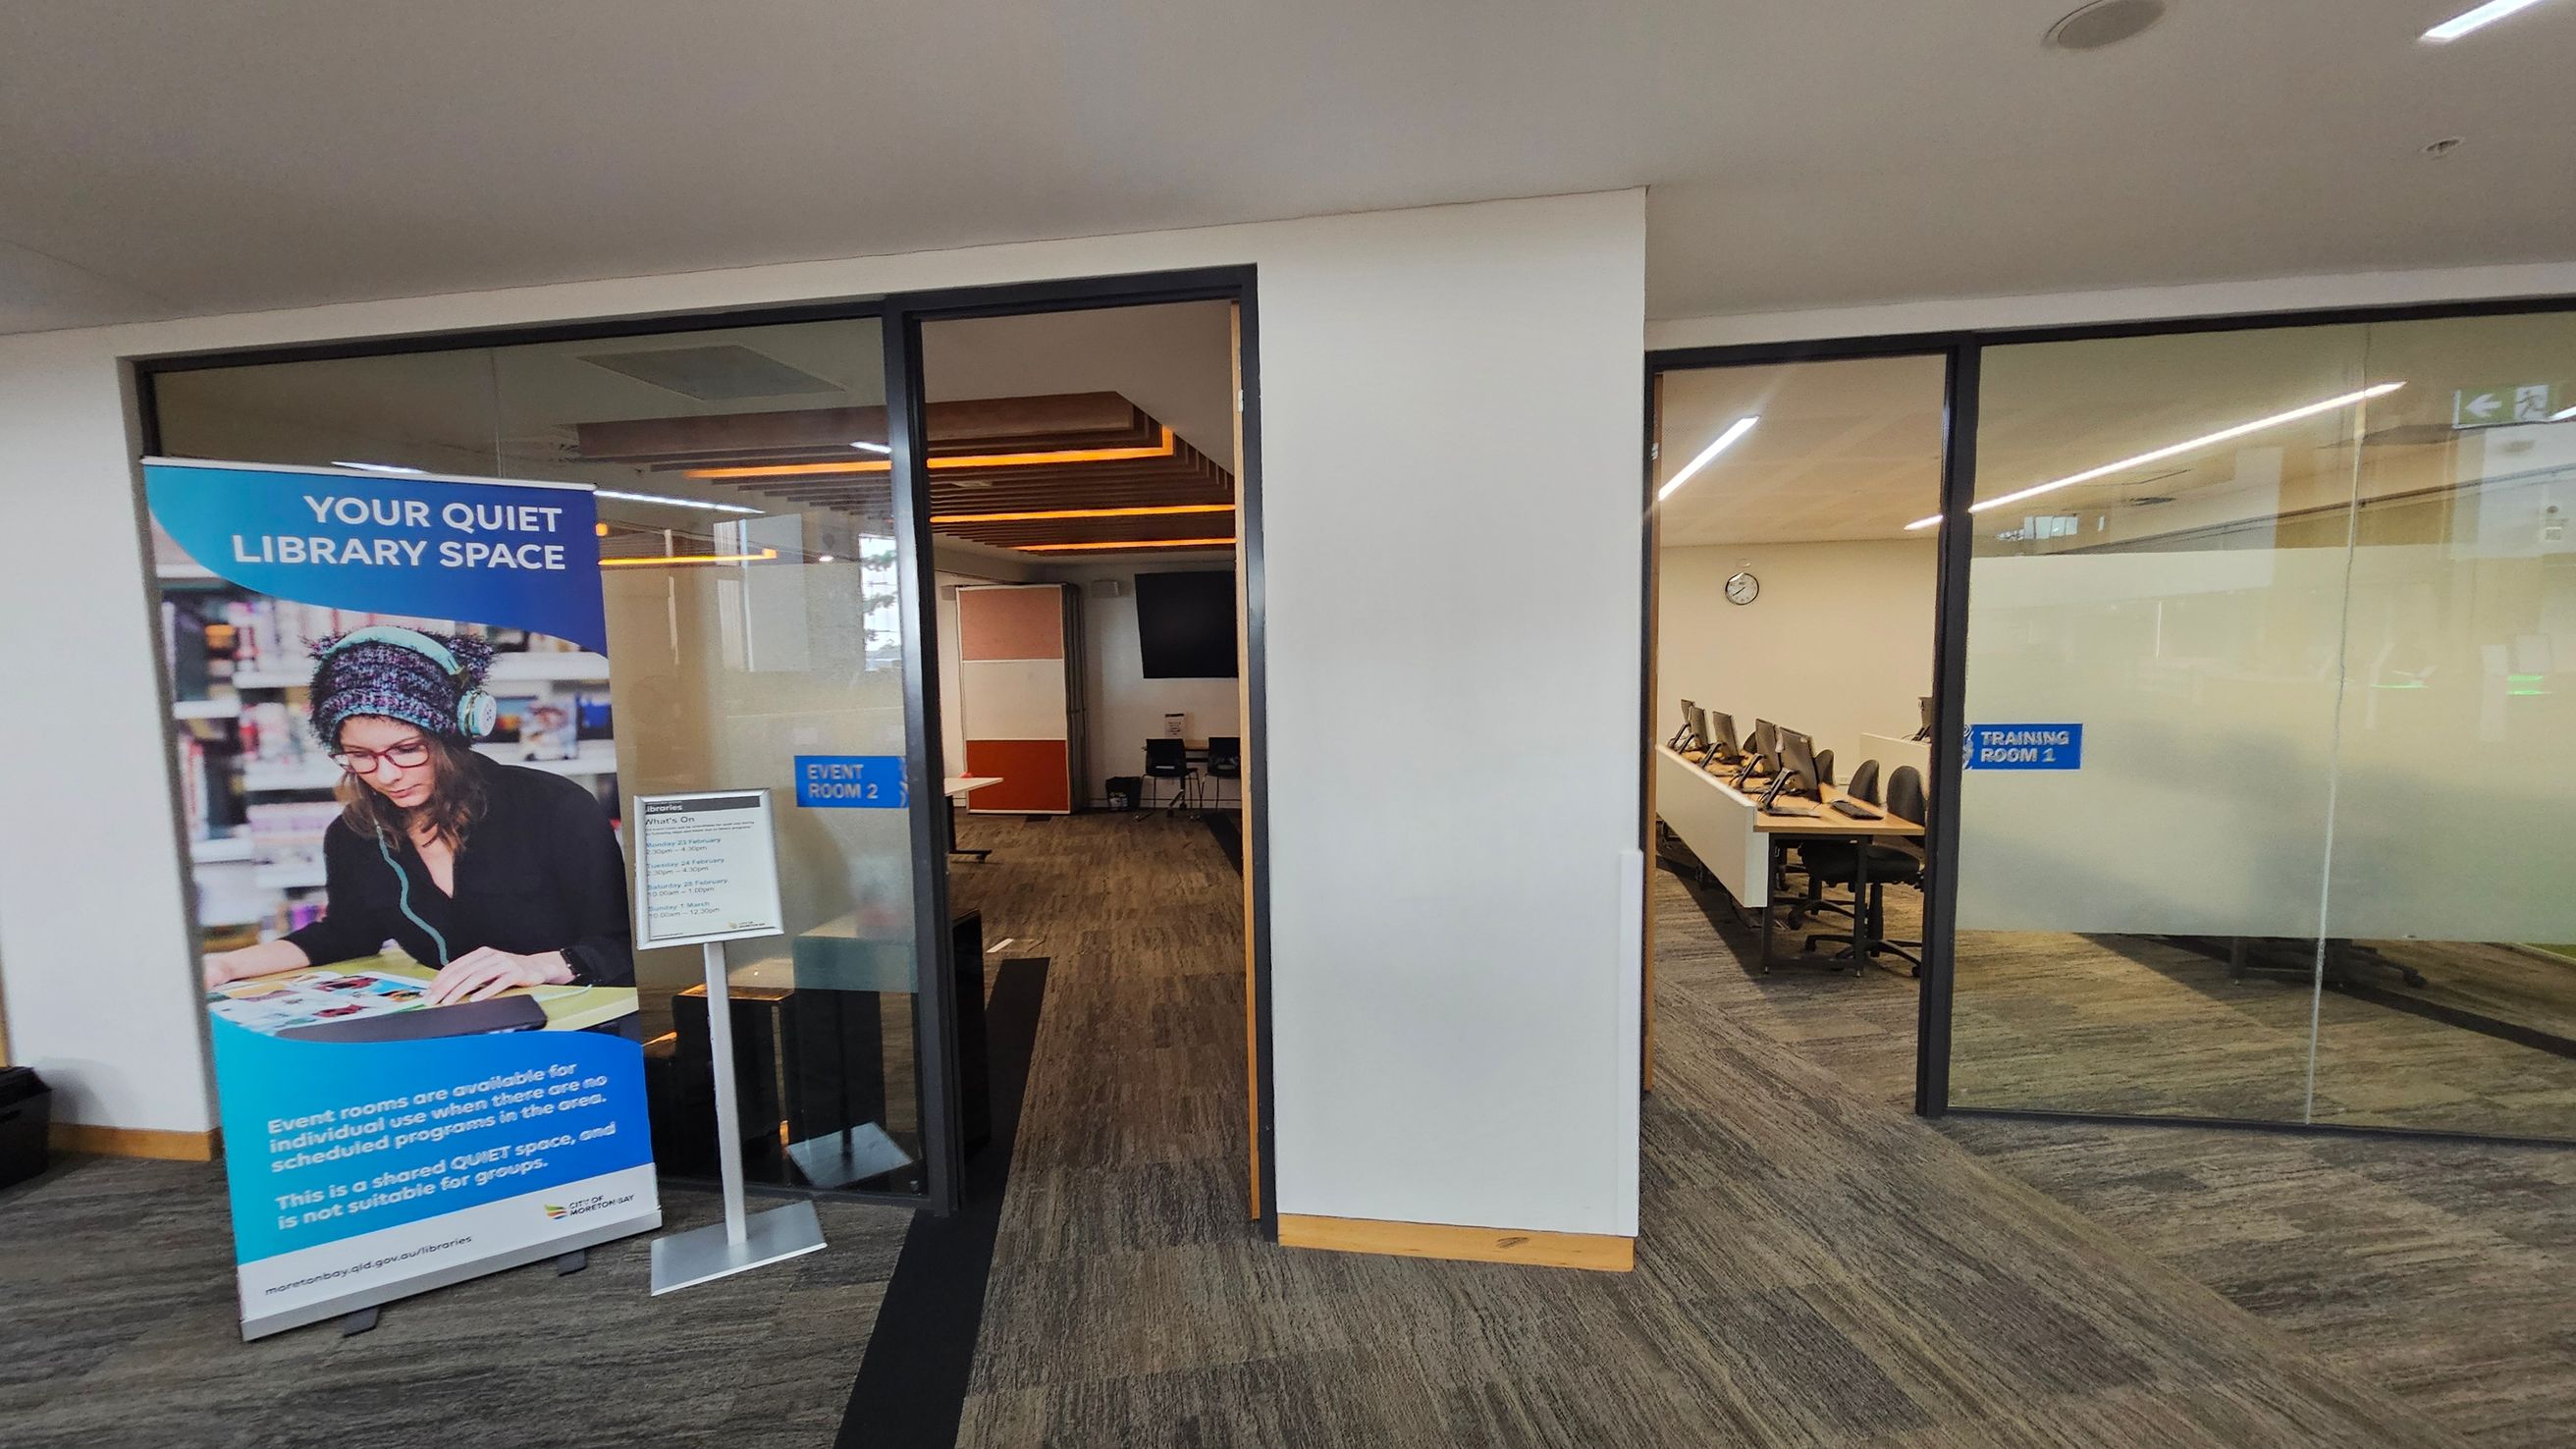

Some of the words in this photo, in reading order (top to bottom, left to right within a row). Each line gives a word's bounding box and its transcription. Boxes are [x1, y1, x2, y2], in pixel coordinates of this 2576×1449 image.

[302, 495, 430, 527] YOUR
[442, 502, 562, 533] QUIET
[232, 534, 426, 565] LIBRARY
[439, 541, 565, 570] SPACE
[1980, 730, 2069, 745] TRAINING
[1980, 747, 2038, 763] ROOM
[2042, 747, 2057, 762] 1
[807, 764, 864, 779] EVENT
[808, 782, 862, 799] ROOM
[866, 783, 879, 799] 2
[646, 816, 677, 826] What's
[268, 1110, 336, 1134] Event
[341, 1097, 408, 1120] rooms
[412, 1089, 448, 1105] are
[453, 1070, 546, 1098] available
[549, 1063, 577, 1078] for
[270, 1117, 385, 1154] individual
[390, 1112, 427, 1128] use
[431, 1099, 488, 1120] when
[492, 1088, 545, 1107] there
[548, 1080, 580, 1096] are
[583, 1076, 608, 1089] no
[271, 1135, 390, 1173] scheduled
[395, 1115, 496, 1150] programs
[499, 1110, 518, 1124] in
[521, 1103, 555, 1119] the
[558, 1094, 607, 1111] area.
[276, 1191, 325, 1210] This
[329, 1185, 349, 1199] is
[351, 1180, 368, 1194] a
[372, 1159, 447, 1189] shared
[450, 1145, 511, 1171] QUIET
[514, 1134, 576, 1157] space,
[578, 1121, 617, 1141] and
[278, 1215, 298, 1230] is
[302, 1204, 344, 1224] not
[348, 1183, 436, 1213] suitable
[440, 1175, 471, 1191] for
[474, 1157, 549, 1187] groups.
[570, 1200, 616, 1216] MORETON
[591, 1195, 605, 1204] OF
[265, 1236, 472, 1295] moretonbay.qld.gov.au/libraries
